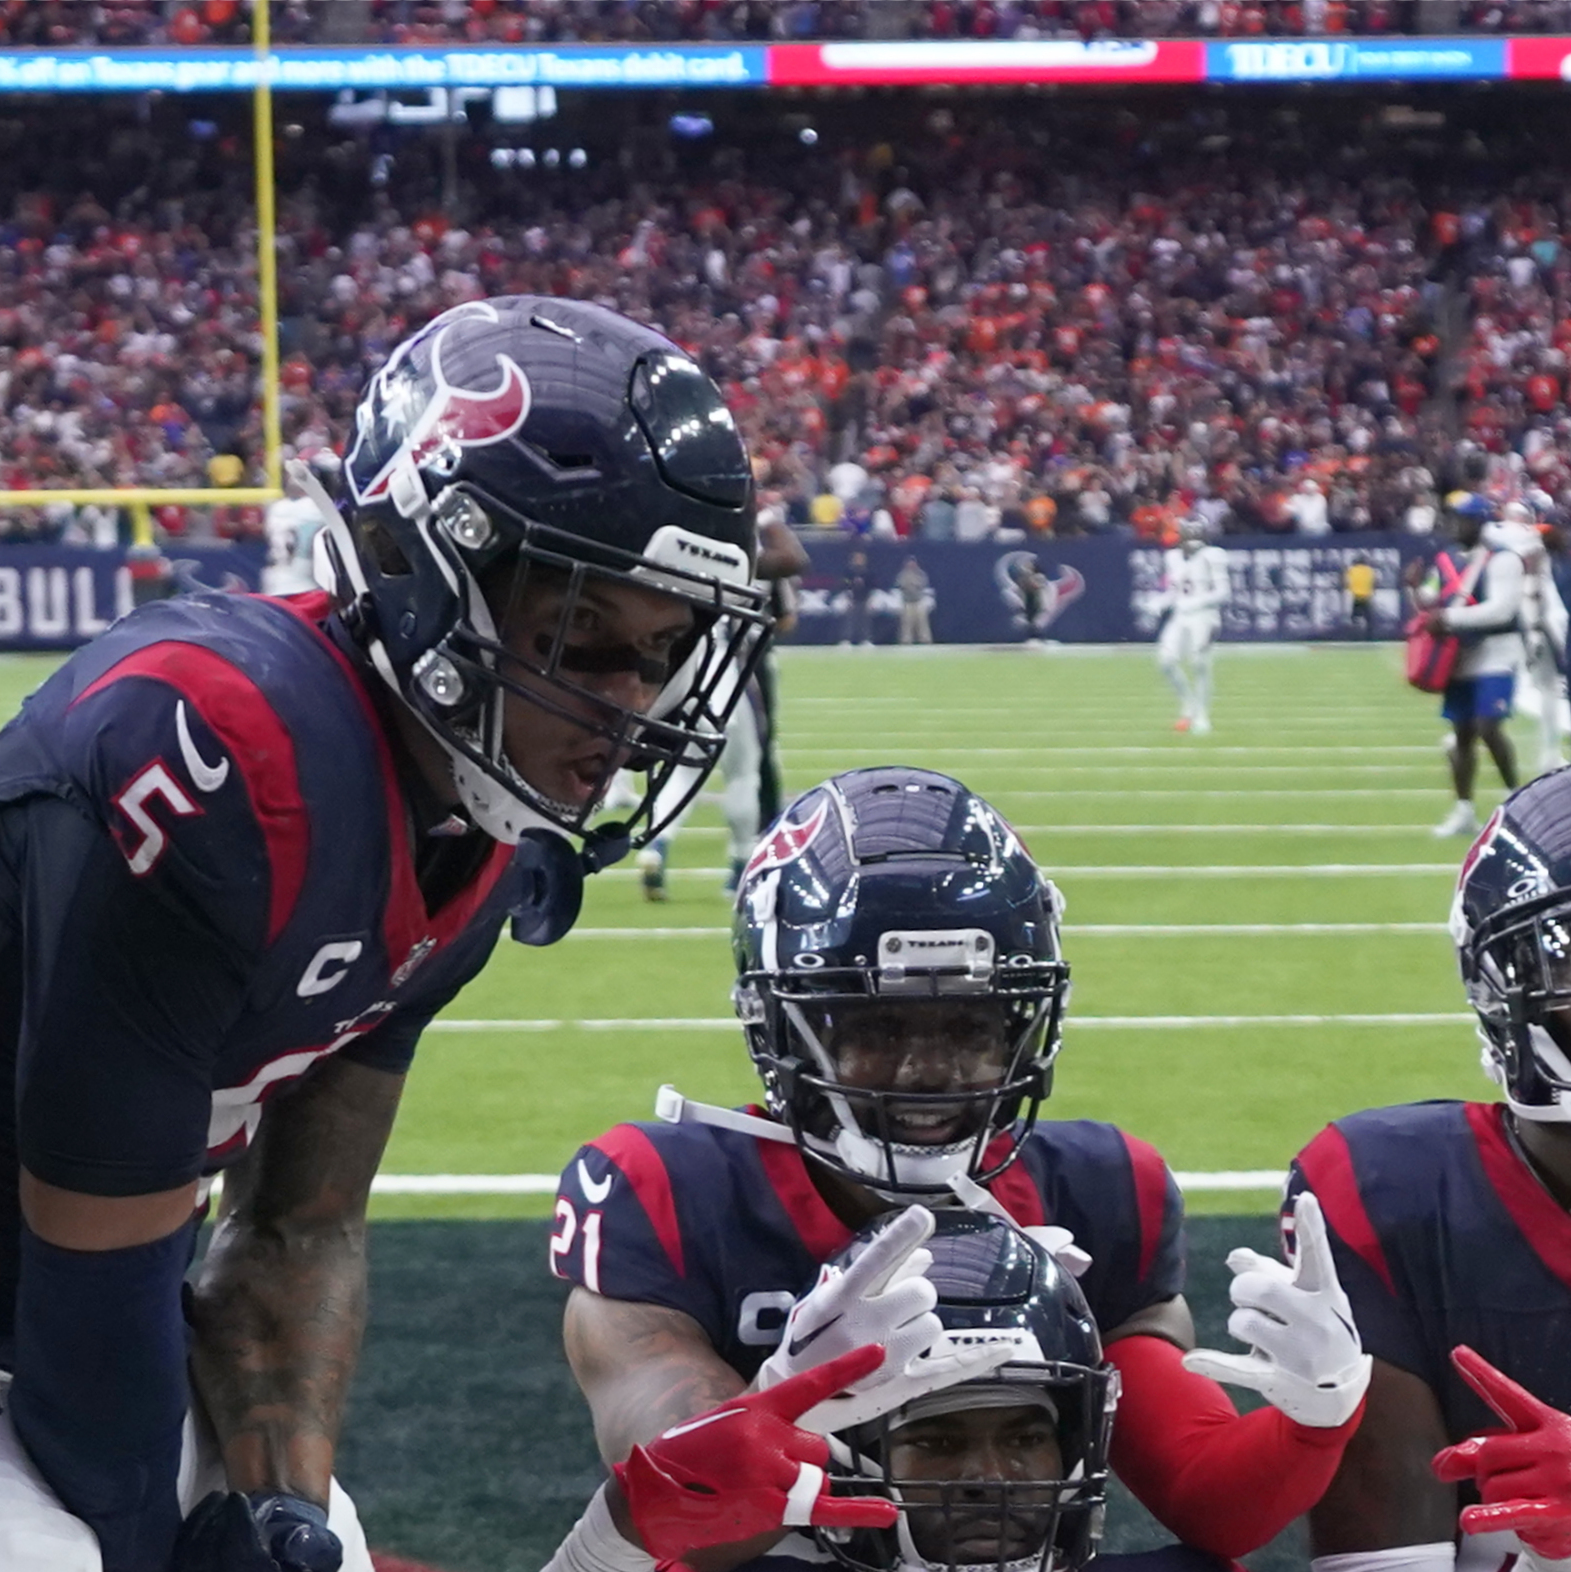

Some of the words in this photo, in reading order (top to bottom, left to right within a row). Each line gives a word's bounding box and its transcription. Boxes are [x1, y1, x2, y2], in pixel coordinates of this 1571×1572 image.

[111, 757, 205, 877] 5
[296, 939, 363, 998] C
[549, 1195, 604, 1296] 21
